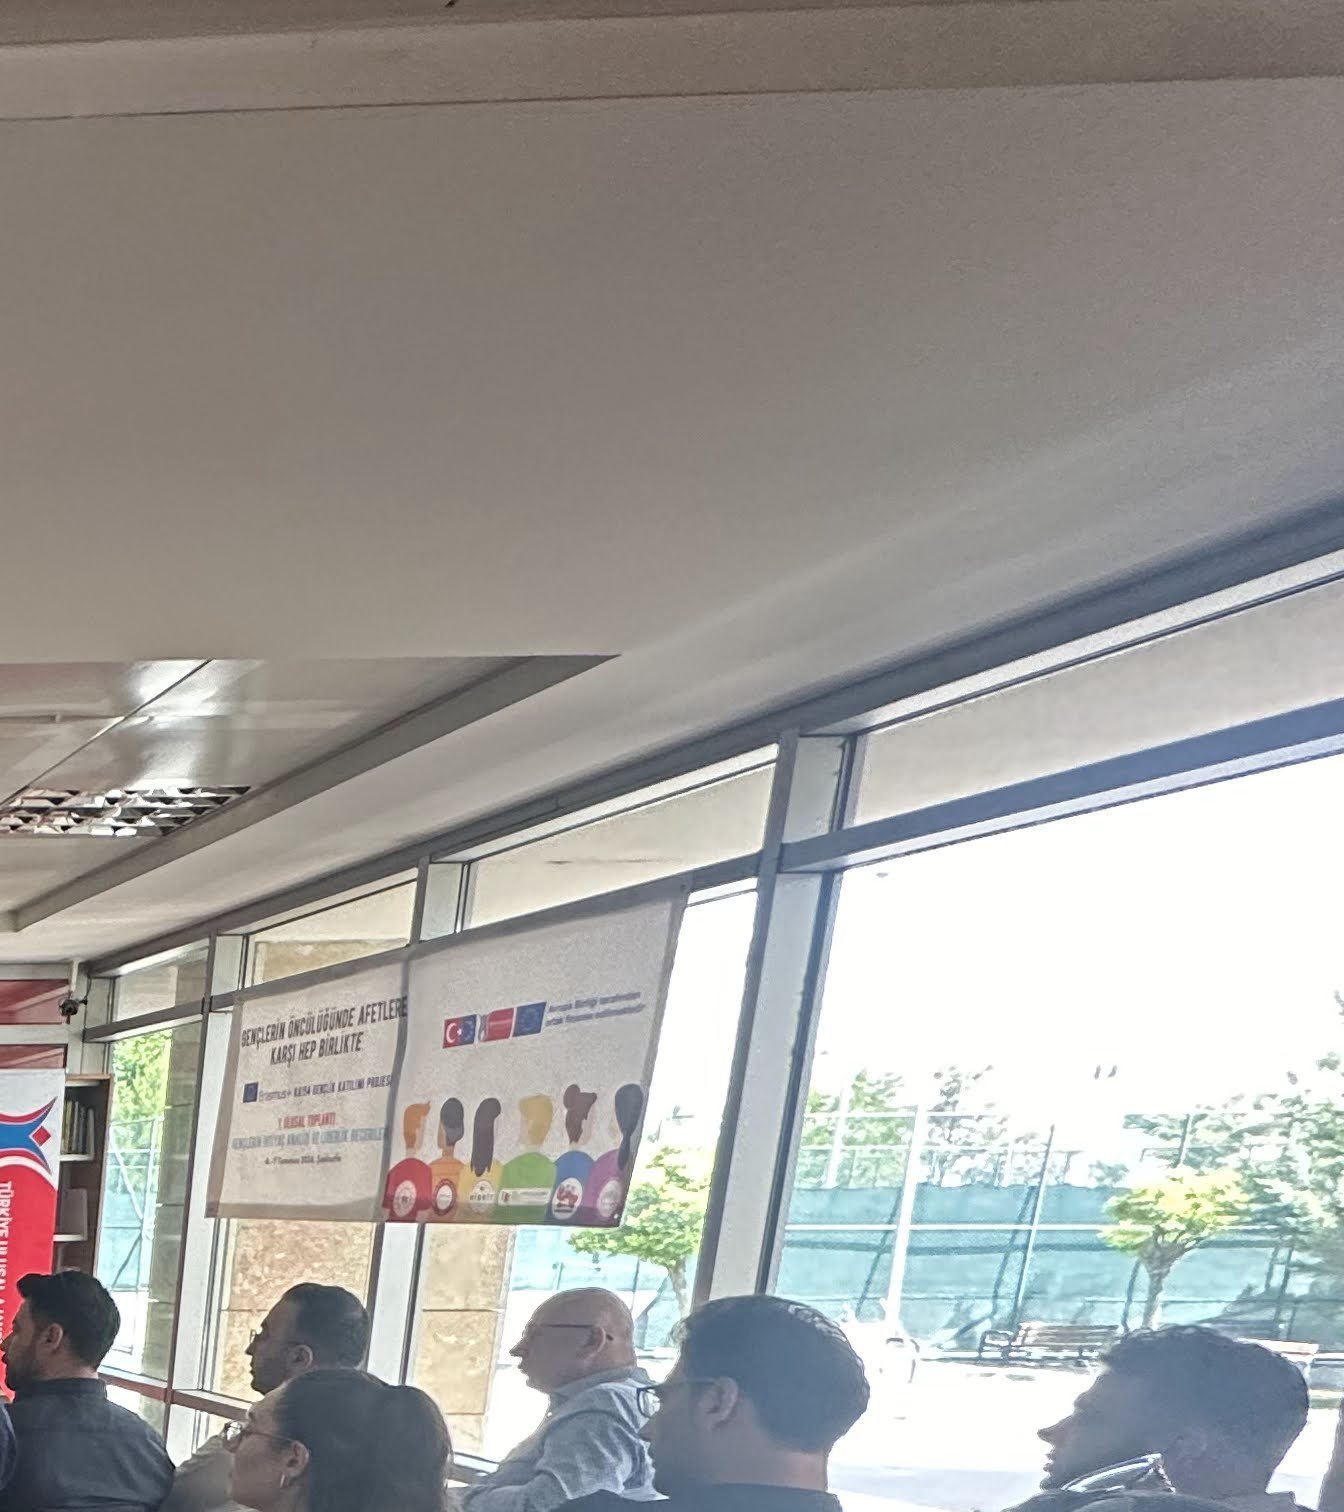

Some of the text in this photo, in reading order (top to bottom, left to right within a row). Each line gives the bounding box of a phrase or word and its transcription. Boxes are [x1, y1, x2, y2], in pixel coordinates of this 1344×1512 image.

[241, 995, 408, 1049] GENÇLERİN ÖNCÜLÜĞÜNDE AFETLERE
[270, 1031, 364, 1068] KARŞI HEP BİRLİKTE
